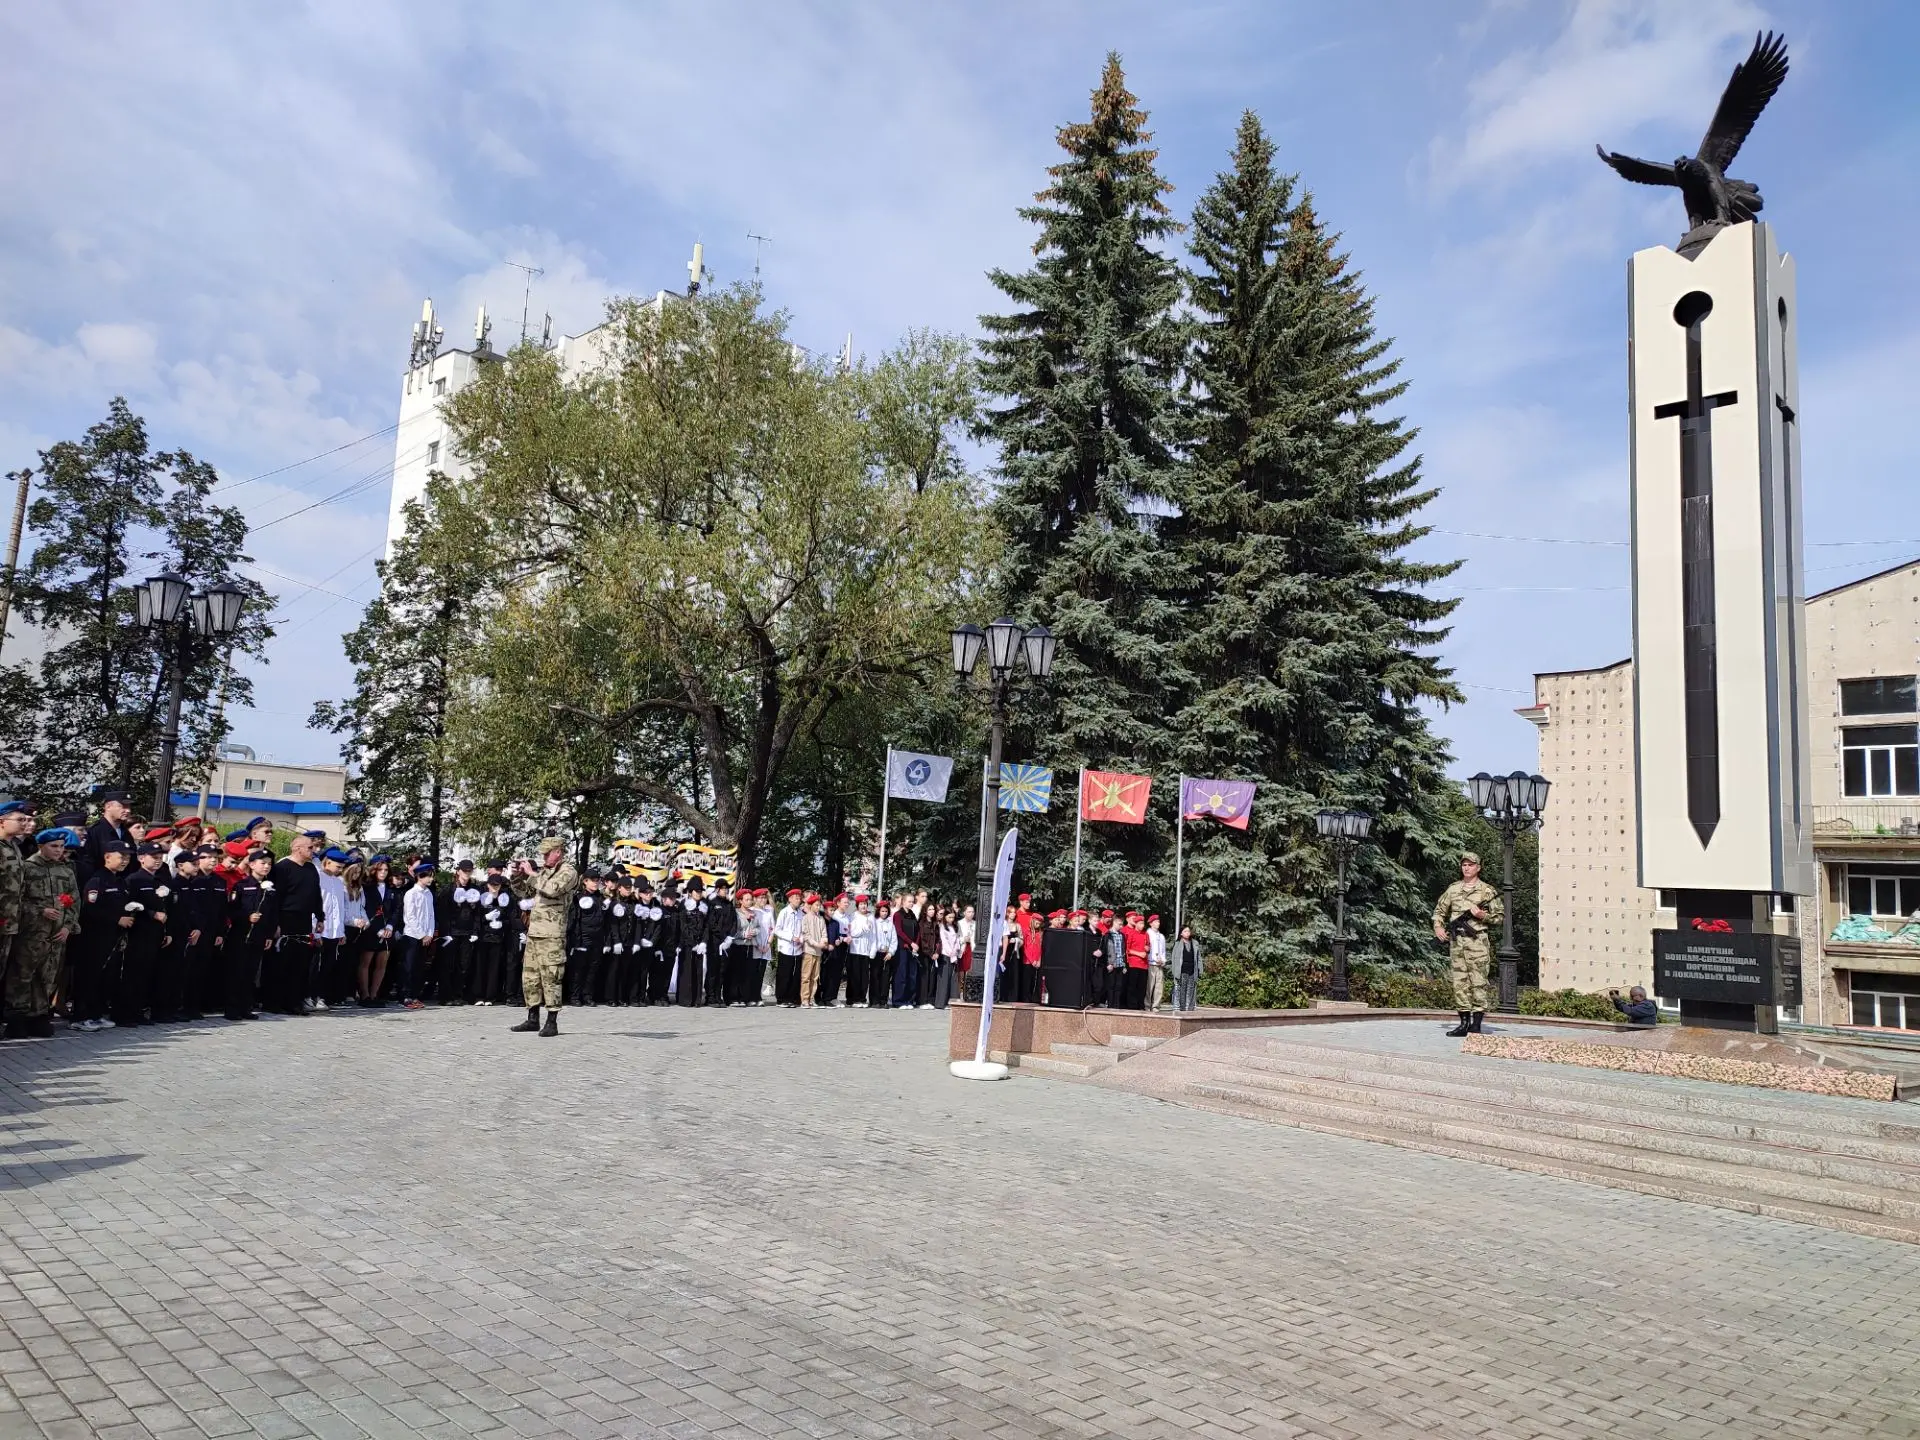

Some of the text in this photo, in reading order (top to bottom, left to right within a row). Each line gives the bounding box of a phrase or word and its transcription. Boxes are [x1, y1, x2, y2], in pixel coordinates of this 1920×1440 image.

[1687, 946, 1734, 955] ПАМЯТНИК
[1686, 964, 1735, 973] ПОГИБШИМ
[1672, 971, 1724, 981] ЛОКАЛЬНЫХ
